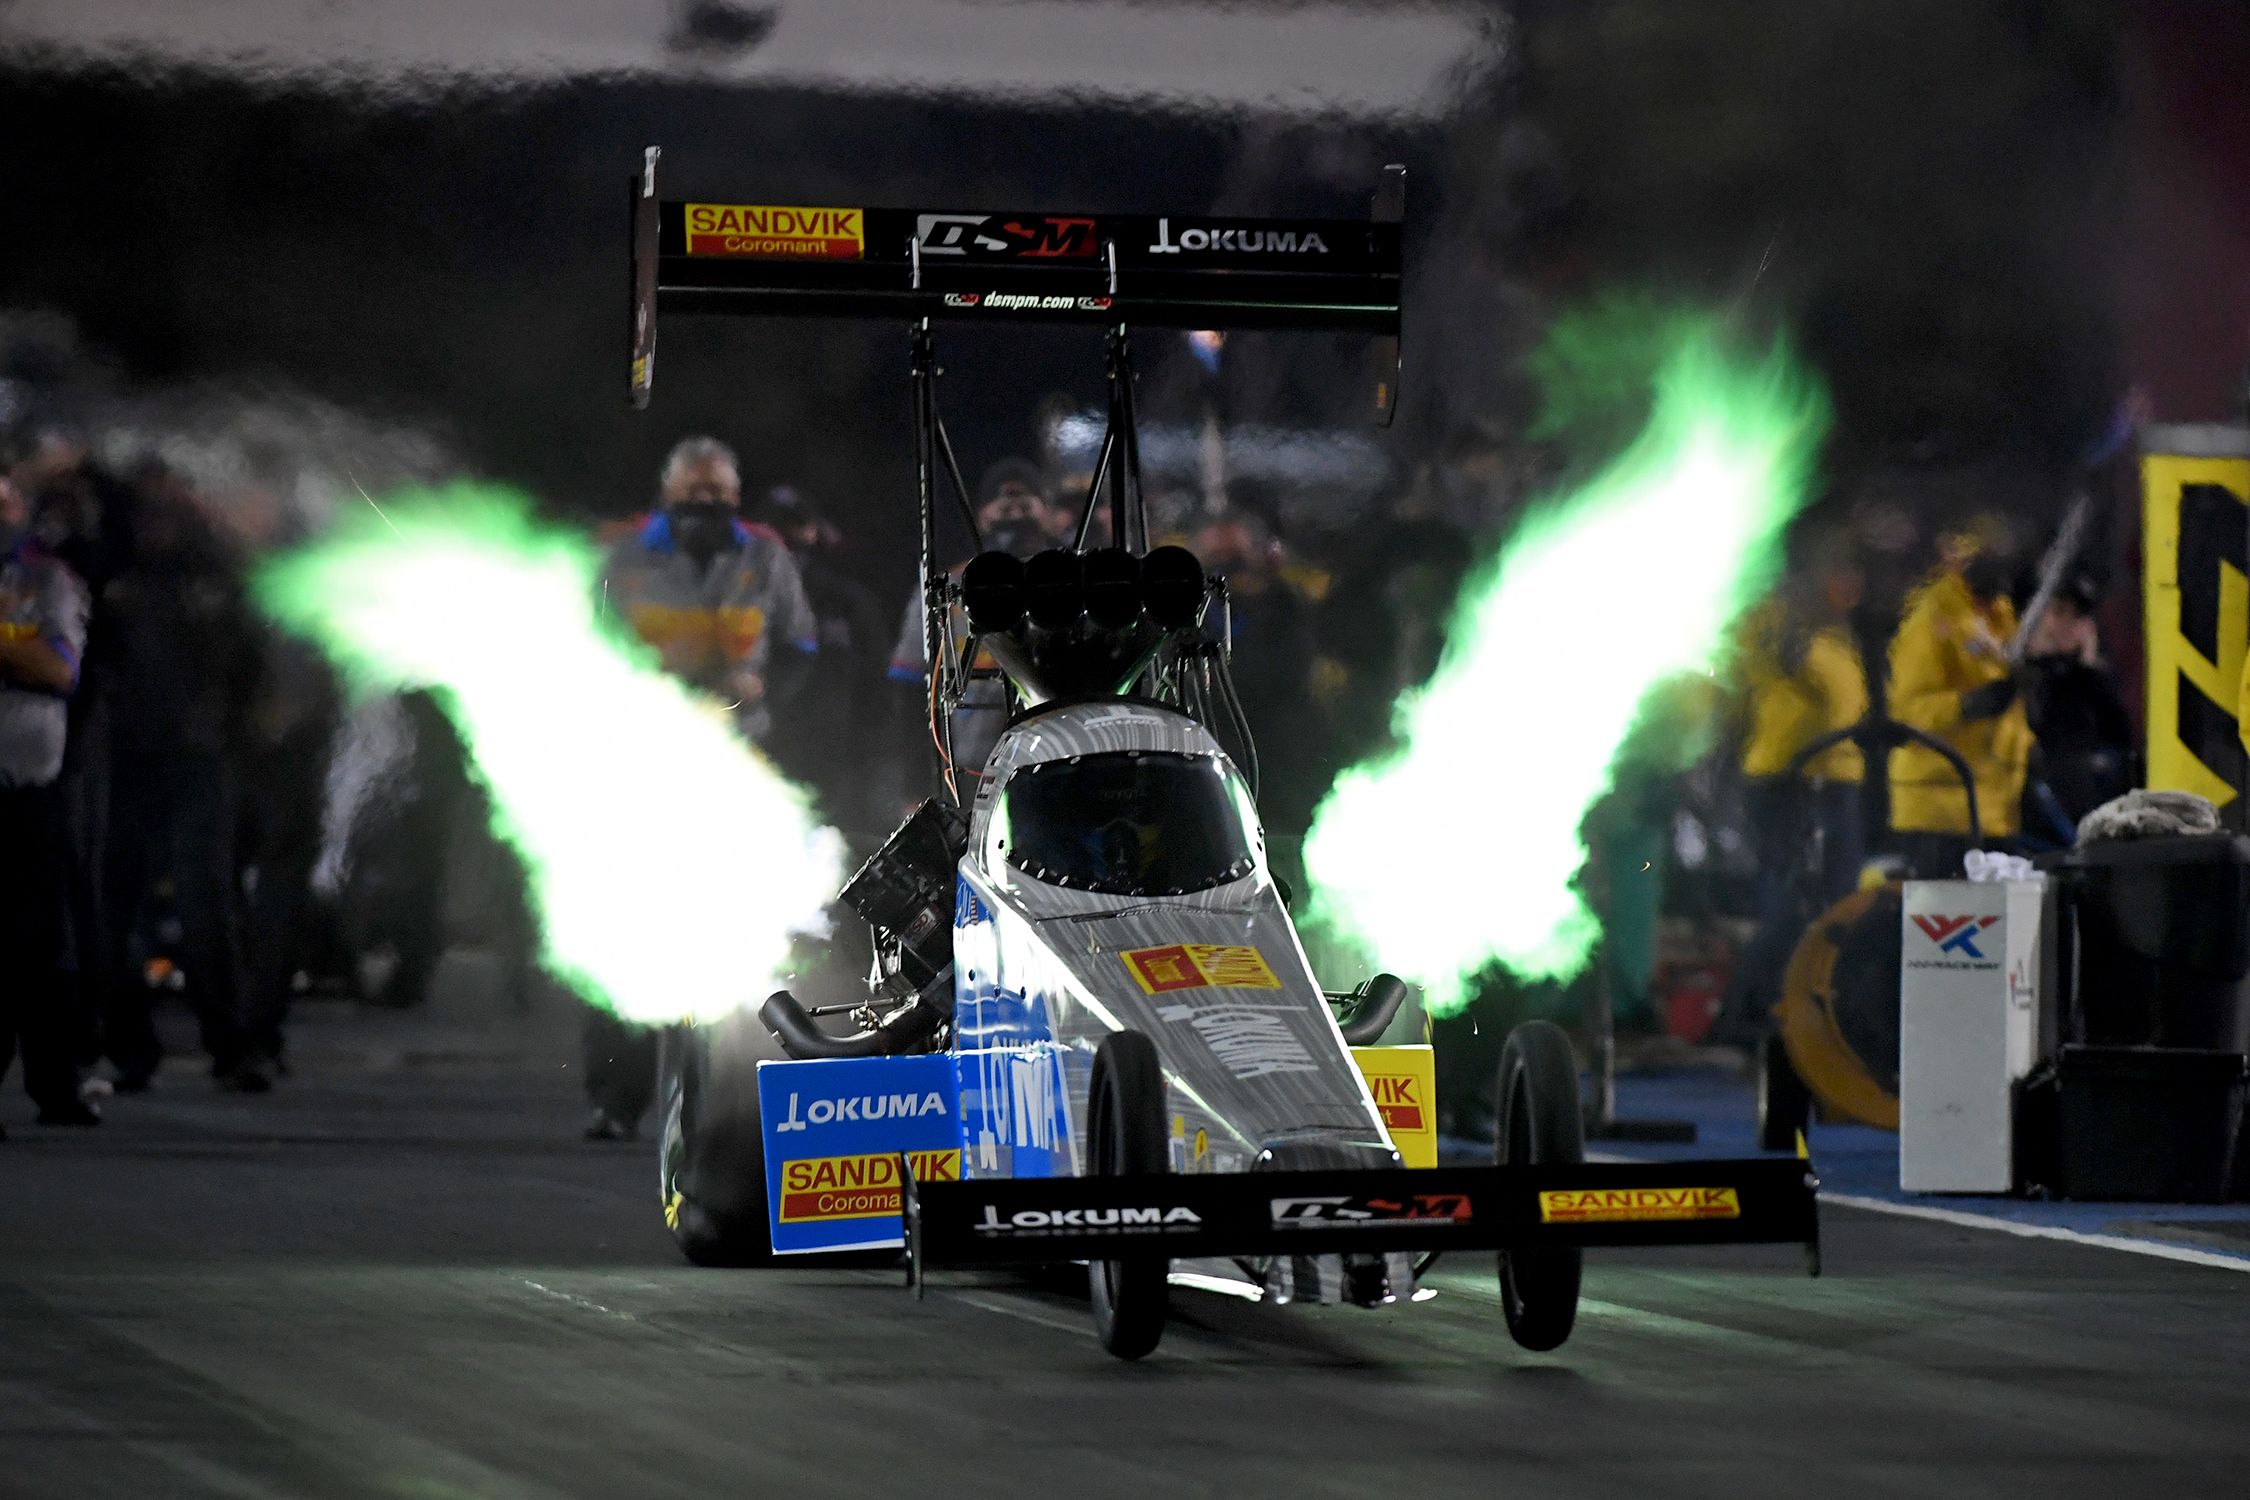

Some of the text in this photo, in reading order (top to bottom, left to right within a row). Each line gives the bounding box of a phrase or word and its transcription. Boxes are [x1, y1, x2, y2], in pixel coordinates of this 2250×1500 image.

[691, 207, 856, 236] SANDVIK
[725, 237, 828, 255] Coromant
[917, 213, 1098, 258] DSM
[1180, 228, 1329, 254] OKUMA
[983, 290, 1075, 310] dsmpm.com
[807, 1091, 947, 1123] OKUMA
[787, 1152, 956, 1191] SANDVIK
[817, 1192, 902, 1213] Coroma
[1549, 1188, 1729, 1209] SANDVIK
[1011, 1206, 1202, 1227] OKUMA
